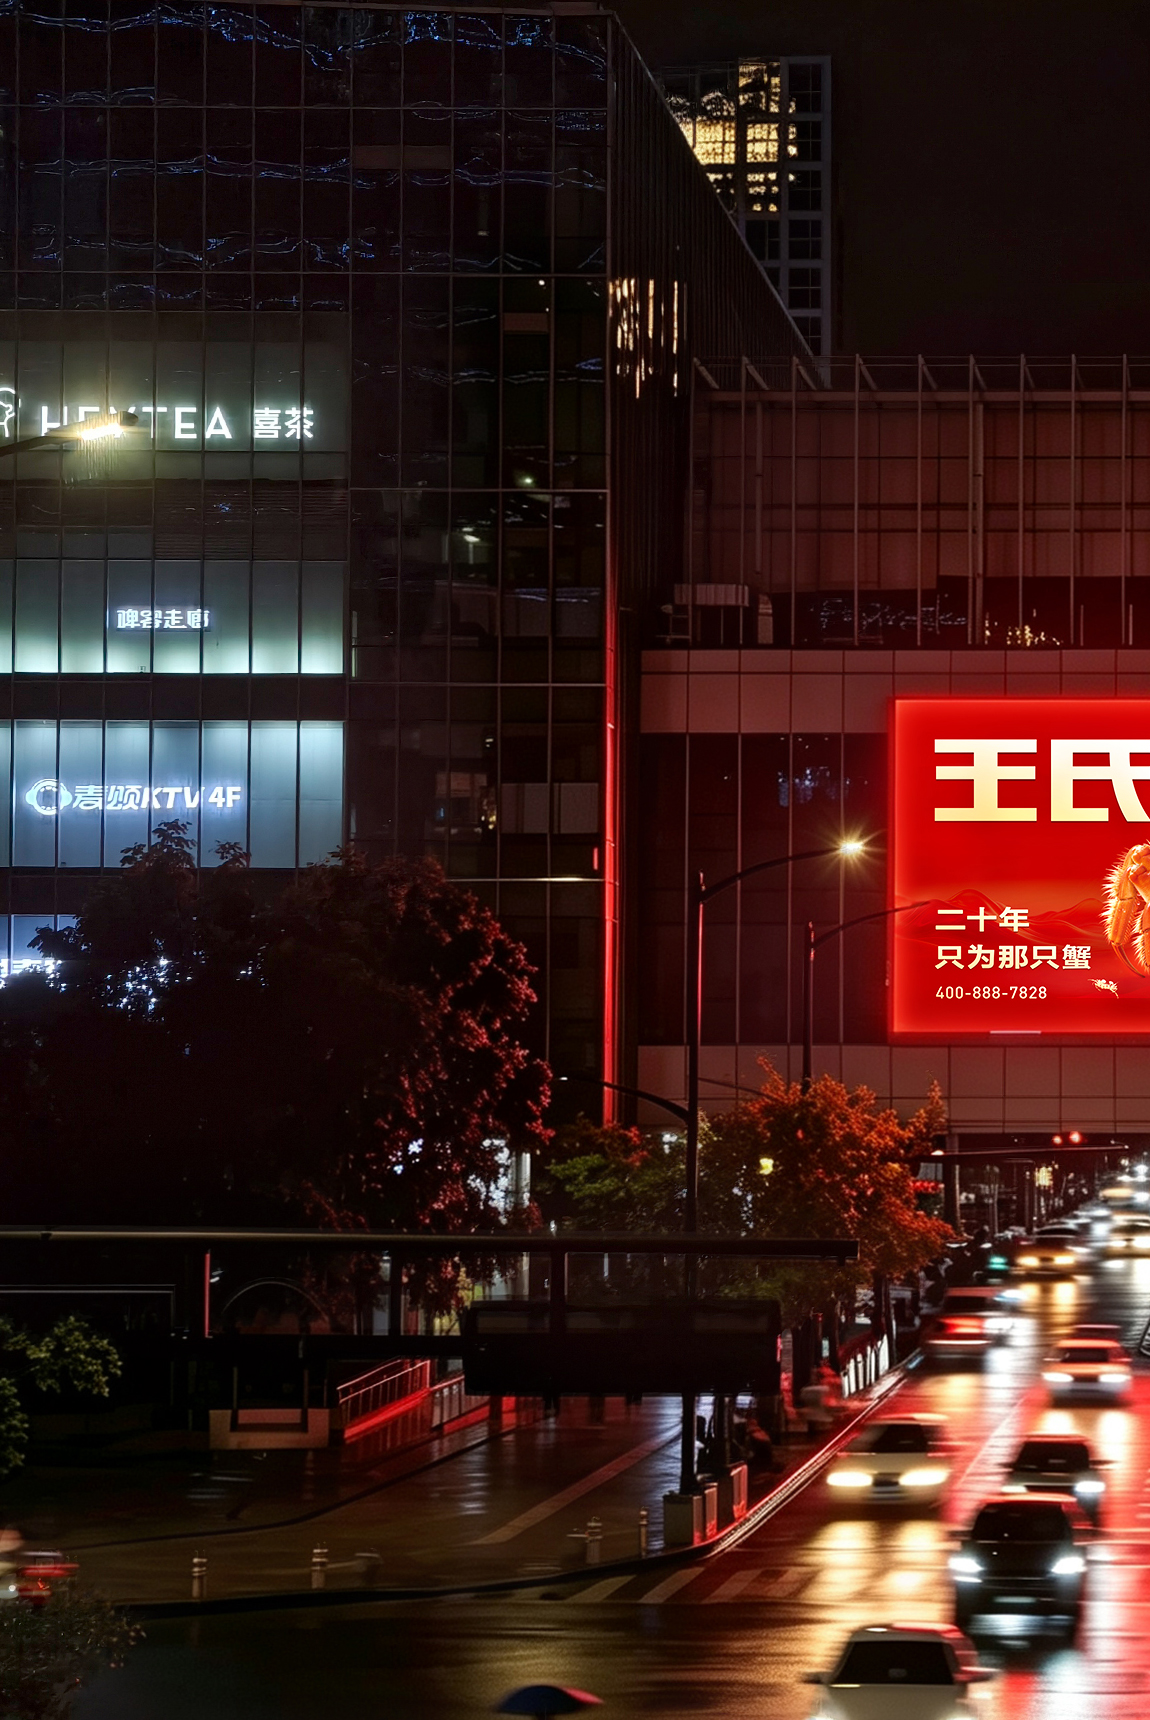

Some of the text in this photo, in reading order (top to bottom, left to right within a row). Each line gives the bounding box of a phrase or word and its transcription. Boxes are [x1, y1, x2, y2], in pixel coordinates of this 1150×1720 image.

[253, 407, 314, 439] 喜茶
[934, 738, 1150, 822] 王氏
[208, 786, 242, 808] 4F
[935, 906, 1030, 933] 二十年
[935, 943, 1092, 970] 只为那只蟹
[935, 985, 1048, 1001] 400-888-7828
